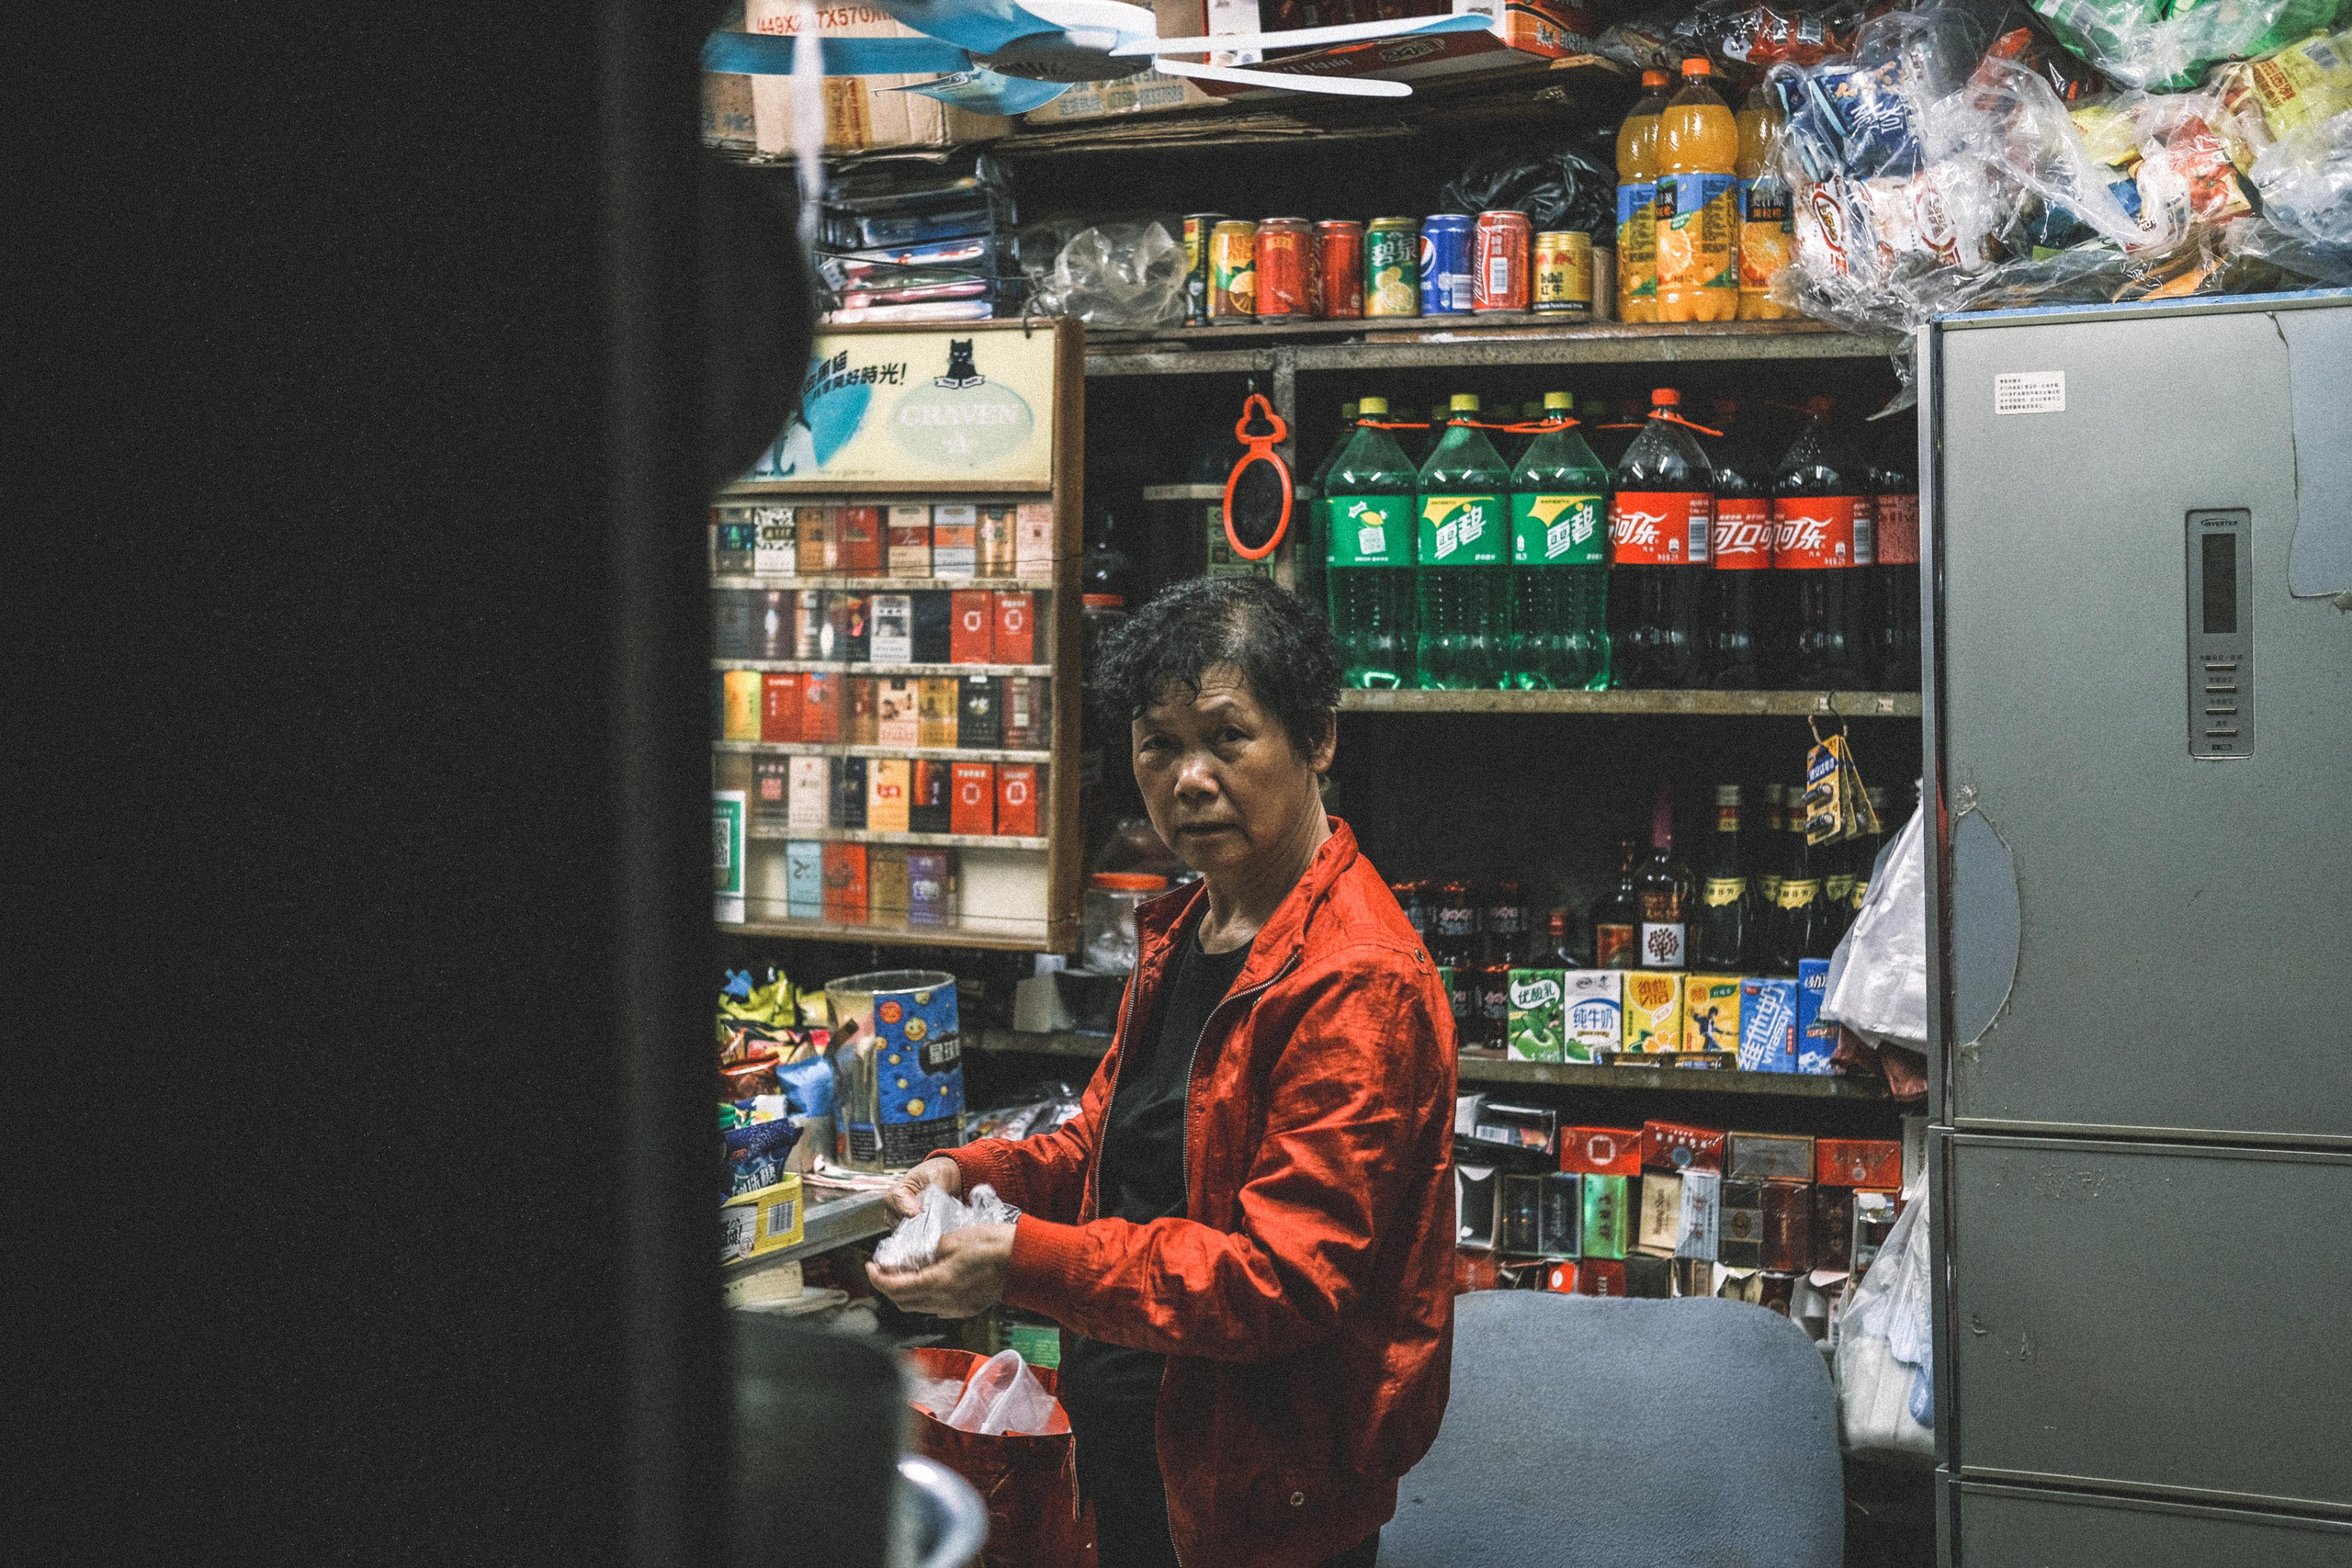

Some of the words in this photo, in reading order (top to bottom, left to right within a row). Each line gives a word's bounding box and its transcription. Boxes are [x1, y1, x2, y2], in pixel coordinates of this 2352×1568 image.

[901, 403, 1018, 426] CRAVEN
[1434, 505, 1487, 559] 雪碧
[1544, 504, 1597, 559] 雪碧
[2204, 519, 2238, 527] INVERTER
[1518, 982, 1555, 1005] 优酸乳
[1573, 1008, 1614, 1029] 纯牛奶
[1762, 1005, 1794, 1064] vitasoy
